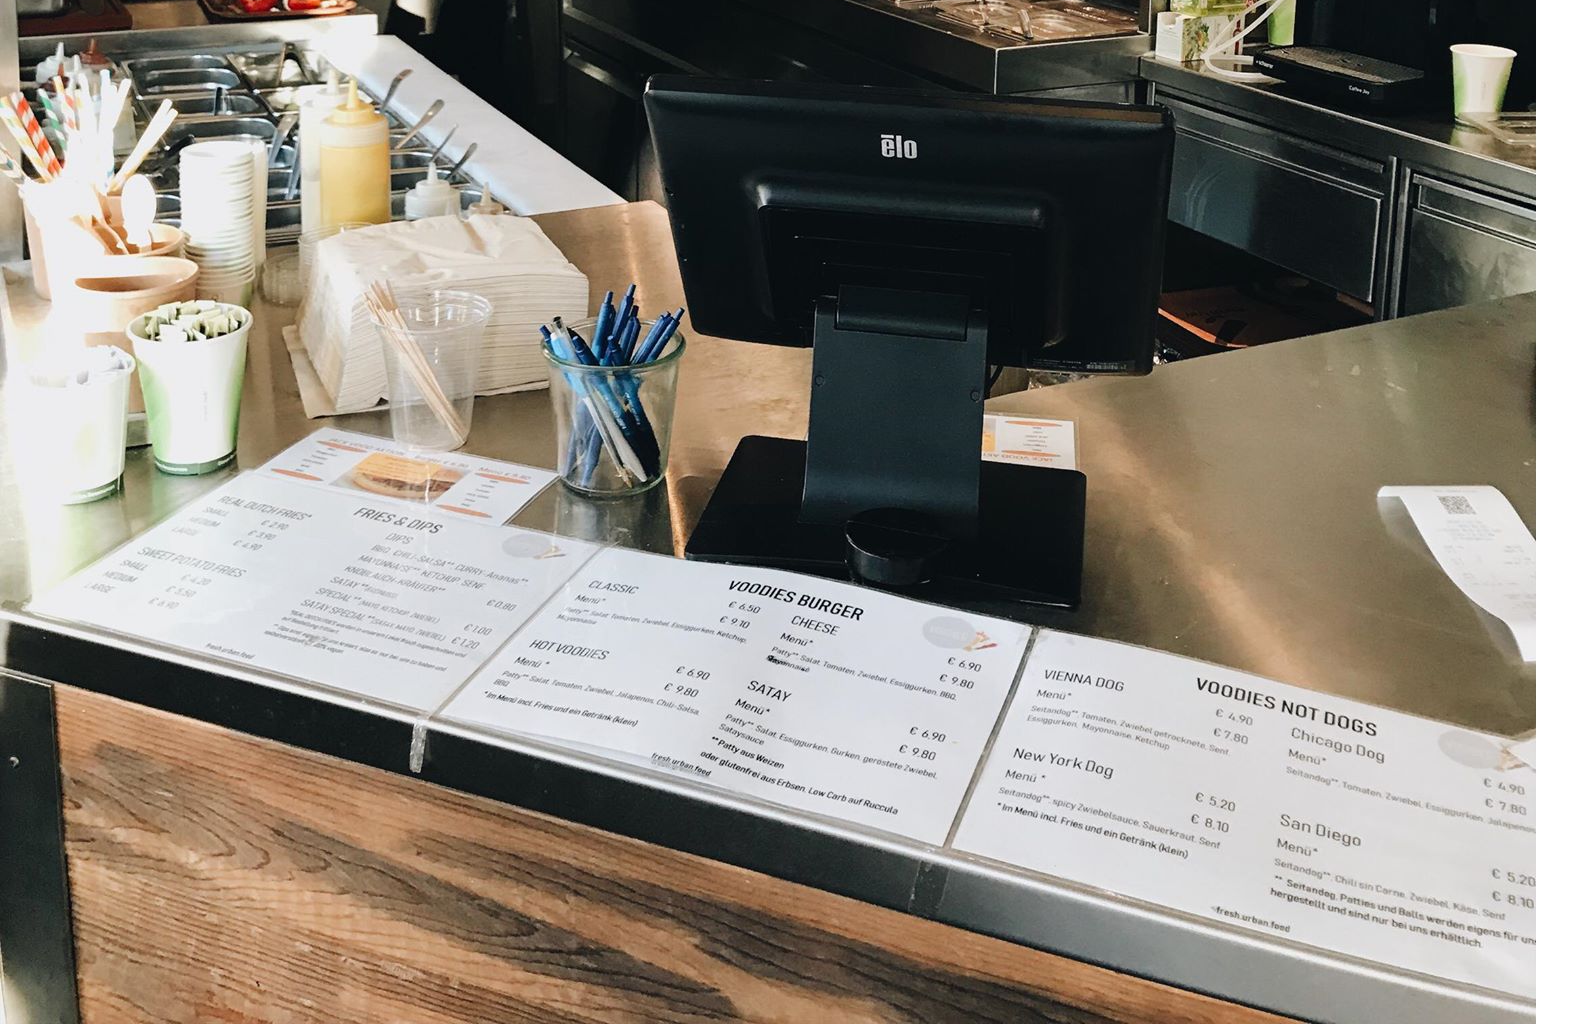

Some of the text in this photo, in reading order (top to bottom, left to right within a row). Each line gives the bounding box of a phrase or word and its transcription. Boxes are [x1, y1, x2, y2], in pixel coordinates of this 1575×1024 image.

[353, 507, 443, 534] FRIES & DIPS
[588, 580, 639, 594] CLASSIC
[729, 580, 864, 621] VOODIES BURGER
[738, 603, 761, 614] 6.50
[791, 615, 840, 635] CHEESE
[529, 639, 610, 660] HOT VOODIES
[676, 666, 711, 680] € 6.90
[947, 657, 982, 672] € 6.90
[664, 683, 699, 698] € 9.80
[939, 674, 975, 689] € 9.80
[1045, 669, 1124, 692] VIENNA DOG
[747, 680, 792, 702] SATAY
[1197, 677, 1377, 736] VOODIES NOT DOGS
[1215, 709, 1253, 726] € 4.90
[719, 723, 765, 745] Sataysauce
[909, 726, 946, 742] € 6.90
[1213, 728, 1248, 745] € 7.80
[899, 744, 936, 761] € 9.80
[1291, 727, 1385, 764] Chicago Dog
[1013, 747, 1114, 780] New York Dog
[700, 751, 719, 762] oder
[718, 759, 761, 778] glutenfrei
[760, 775, 776, 784] aus
[808, 787, 826, 797] Low
[826, 791, 847, 802] Carb
[863, 799, 898, 815] Ruccula
[1195, 792, 1236, 812] € 5.20
[1002, 803, 1188, 859] Im Menü incl. Fries und ein Getränk (klein)
[1191, 814, 1229, 833] € 8.10
[1280, 814, 1361, 847] San Diego
[1491, 868, 1536, 887] € 5.20
[1492, 891, 1534, 909] € 8.10
